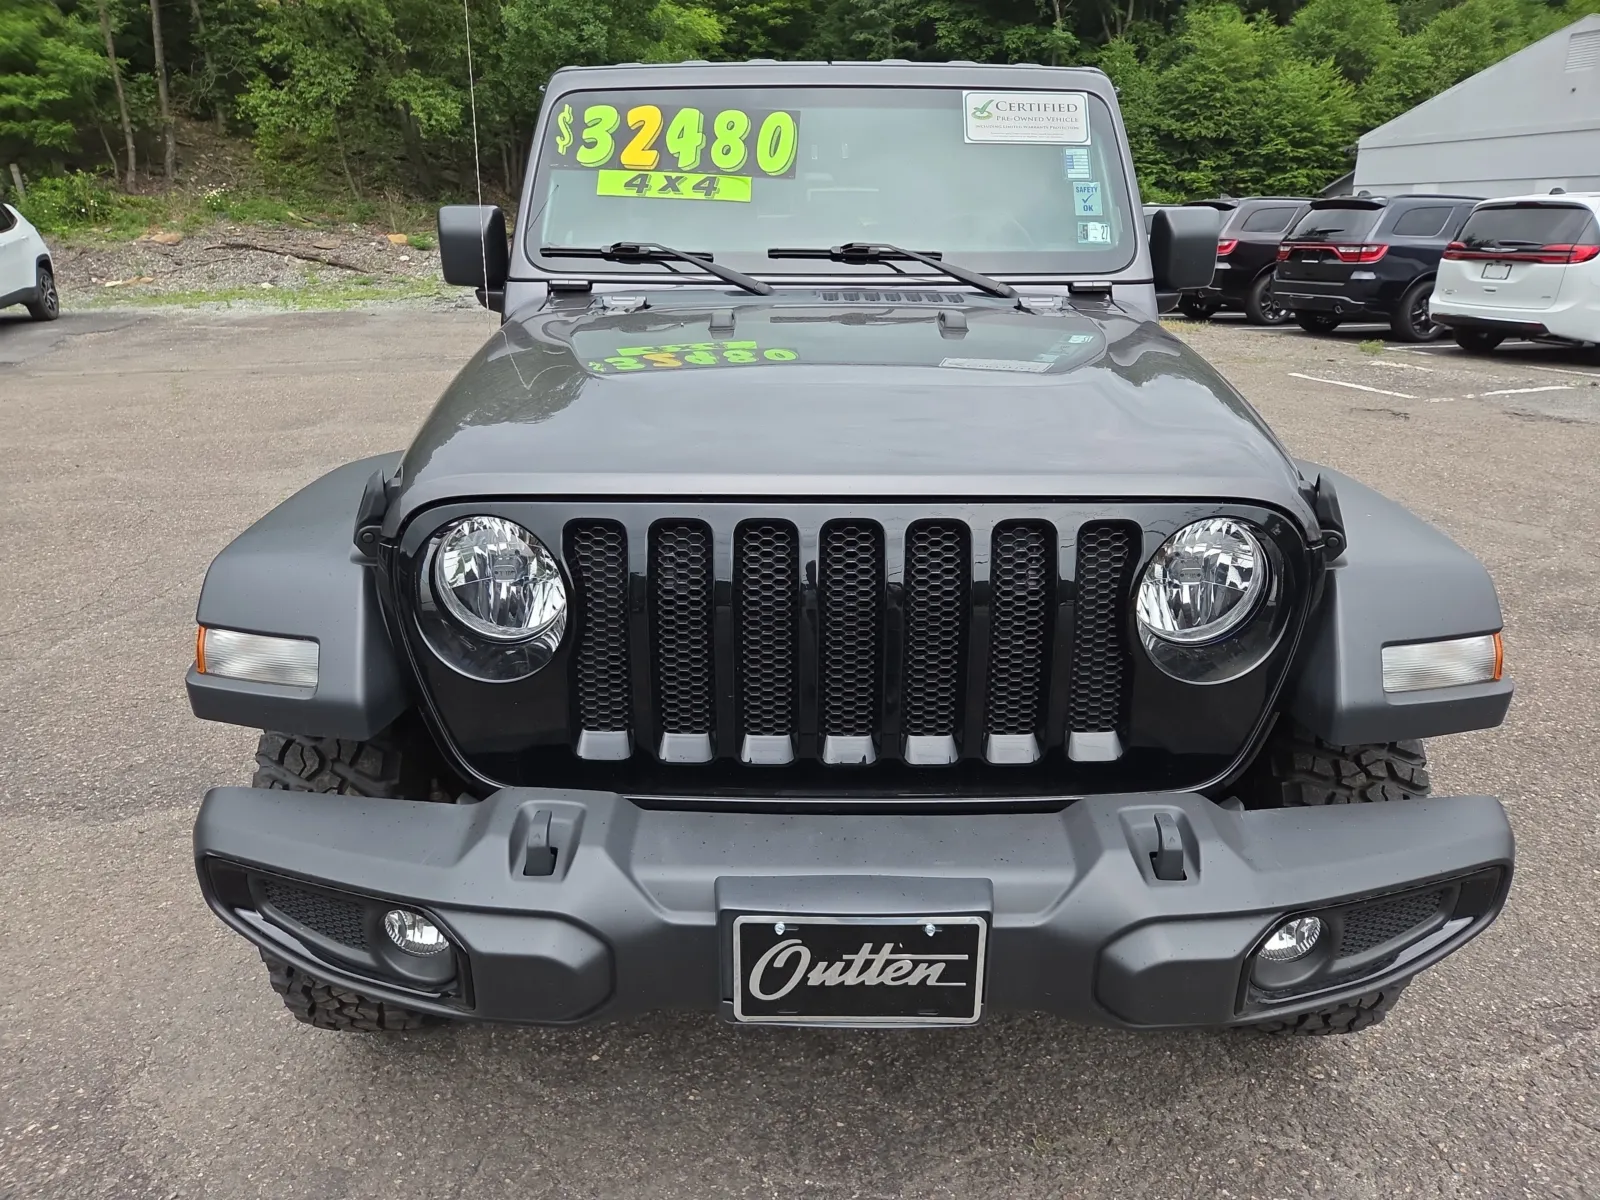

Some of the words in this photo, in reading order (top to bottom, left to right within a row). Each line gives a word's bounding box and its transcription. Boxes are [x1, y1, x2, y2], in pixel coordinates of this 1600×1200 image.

[995, 100, 1078, 113] CERTIFIED
[1046, 115, 1079, 123] VEHICLE
[555, 104, 798, 176] $32480
[1083, 204, 1094, 212] OK
[1101, 225, 1109, 240] 27
[749, 939, 969, 1000] Outten
